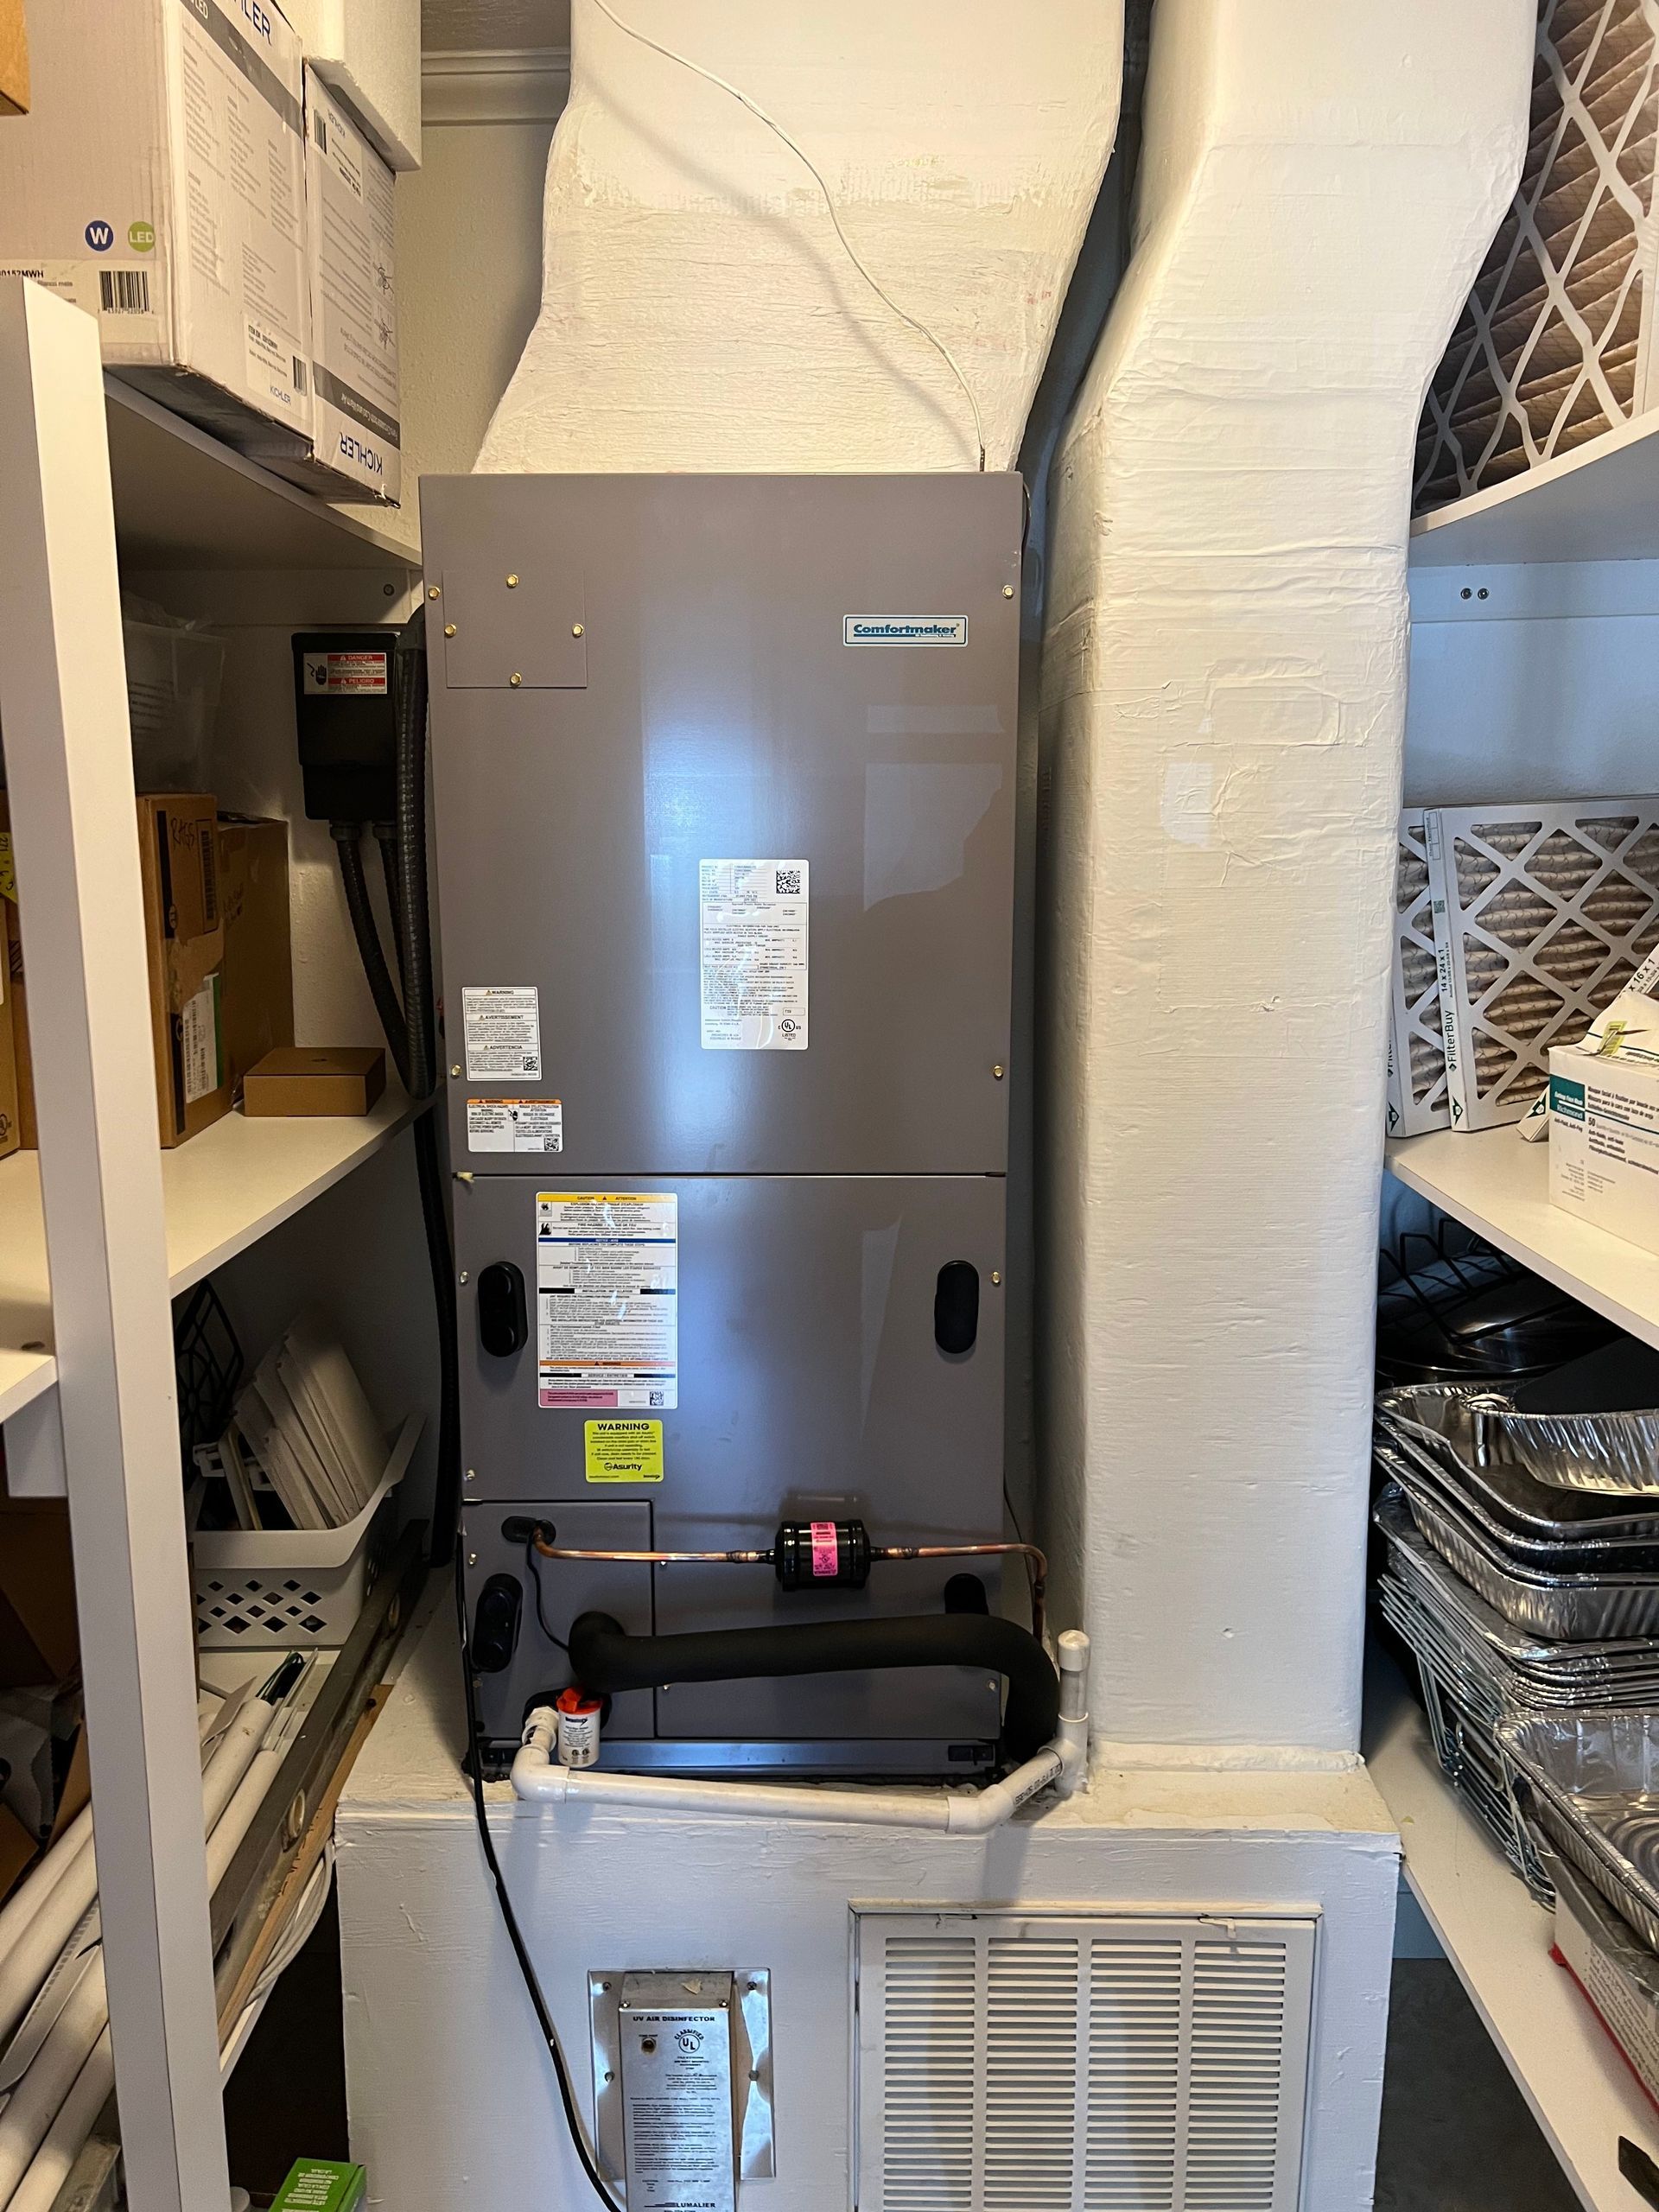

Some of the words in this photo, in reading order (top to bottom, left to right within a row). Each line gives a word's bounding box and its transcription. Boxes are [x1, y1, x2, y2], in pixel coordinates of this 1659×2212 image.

[90, 227, 109, 245] W
[130, 232, 154, 243] LED
[0, 270, 43, 278] 0152MWH
[270, 386, 291, 405] KICHLER
[340, 432, 382, 475] KICHLER
[854, 624, 957, 633] Comfortmaker
[1440, 963, 1446, 973] 24
[1634, 972, 1644, 982] 16
[1444, 1010, 1457, 1062] FilterBuy
[1556, 1104, 1583, 1119] Richmond
[1588, 1117, 1596, 1127] 50
[674, 2029, 704, 2040] CLASSIFIED
[682, 2037, 696, 2050] UL
